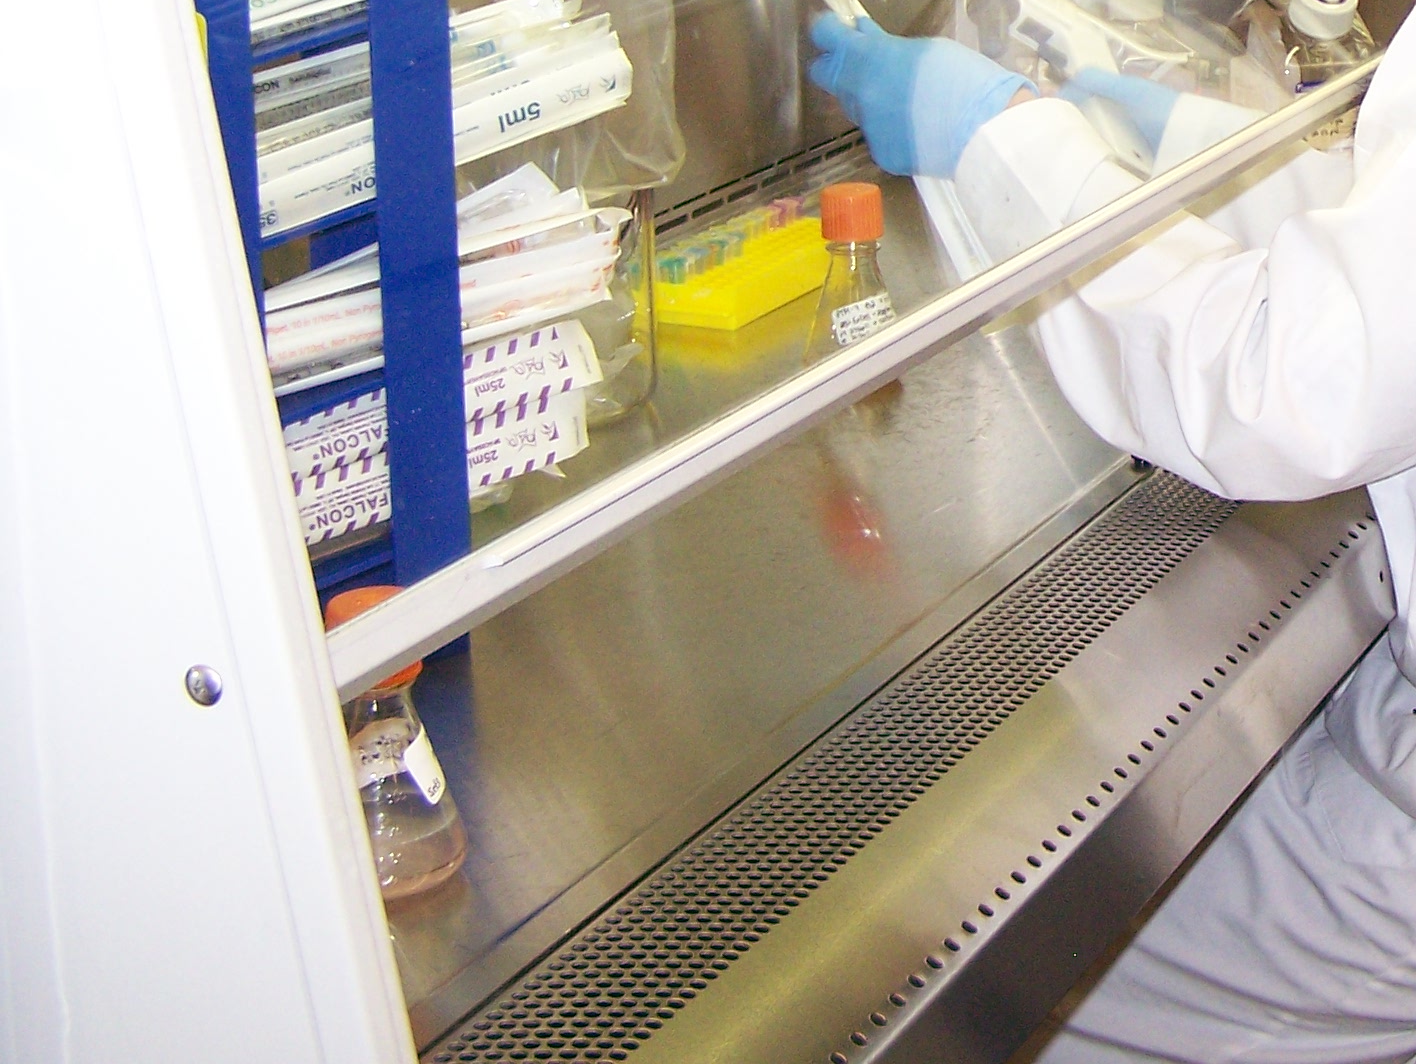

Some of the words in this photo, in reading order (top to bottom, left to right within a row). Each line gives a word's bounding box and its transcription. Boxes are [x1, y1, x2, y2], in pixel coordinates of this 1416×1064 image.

[498, 101, 541, 133] 5ml
[474, 377, 506, 397] 25ml
[468, 449, 499, 469] 25ml
